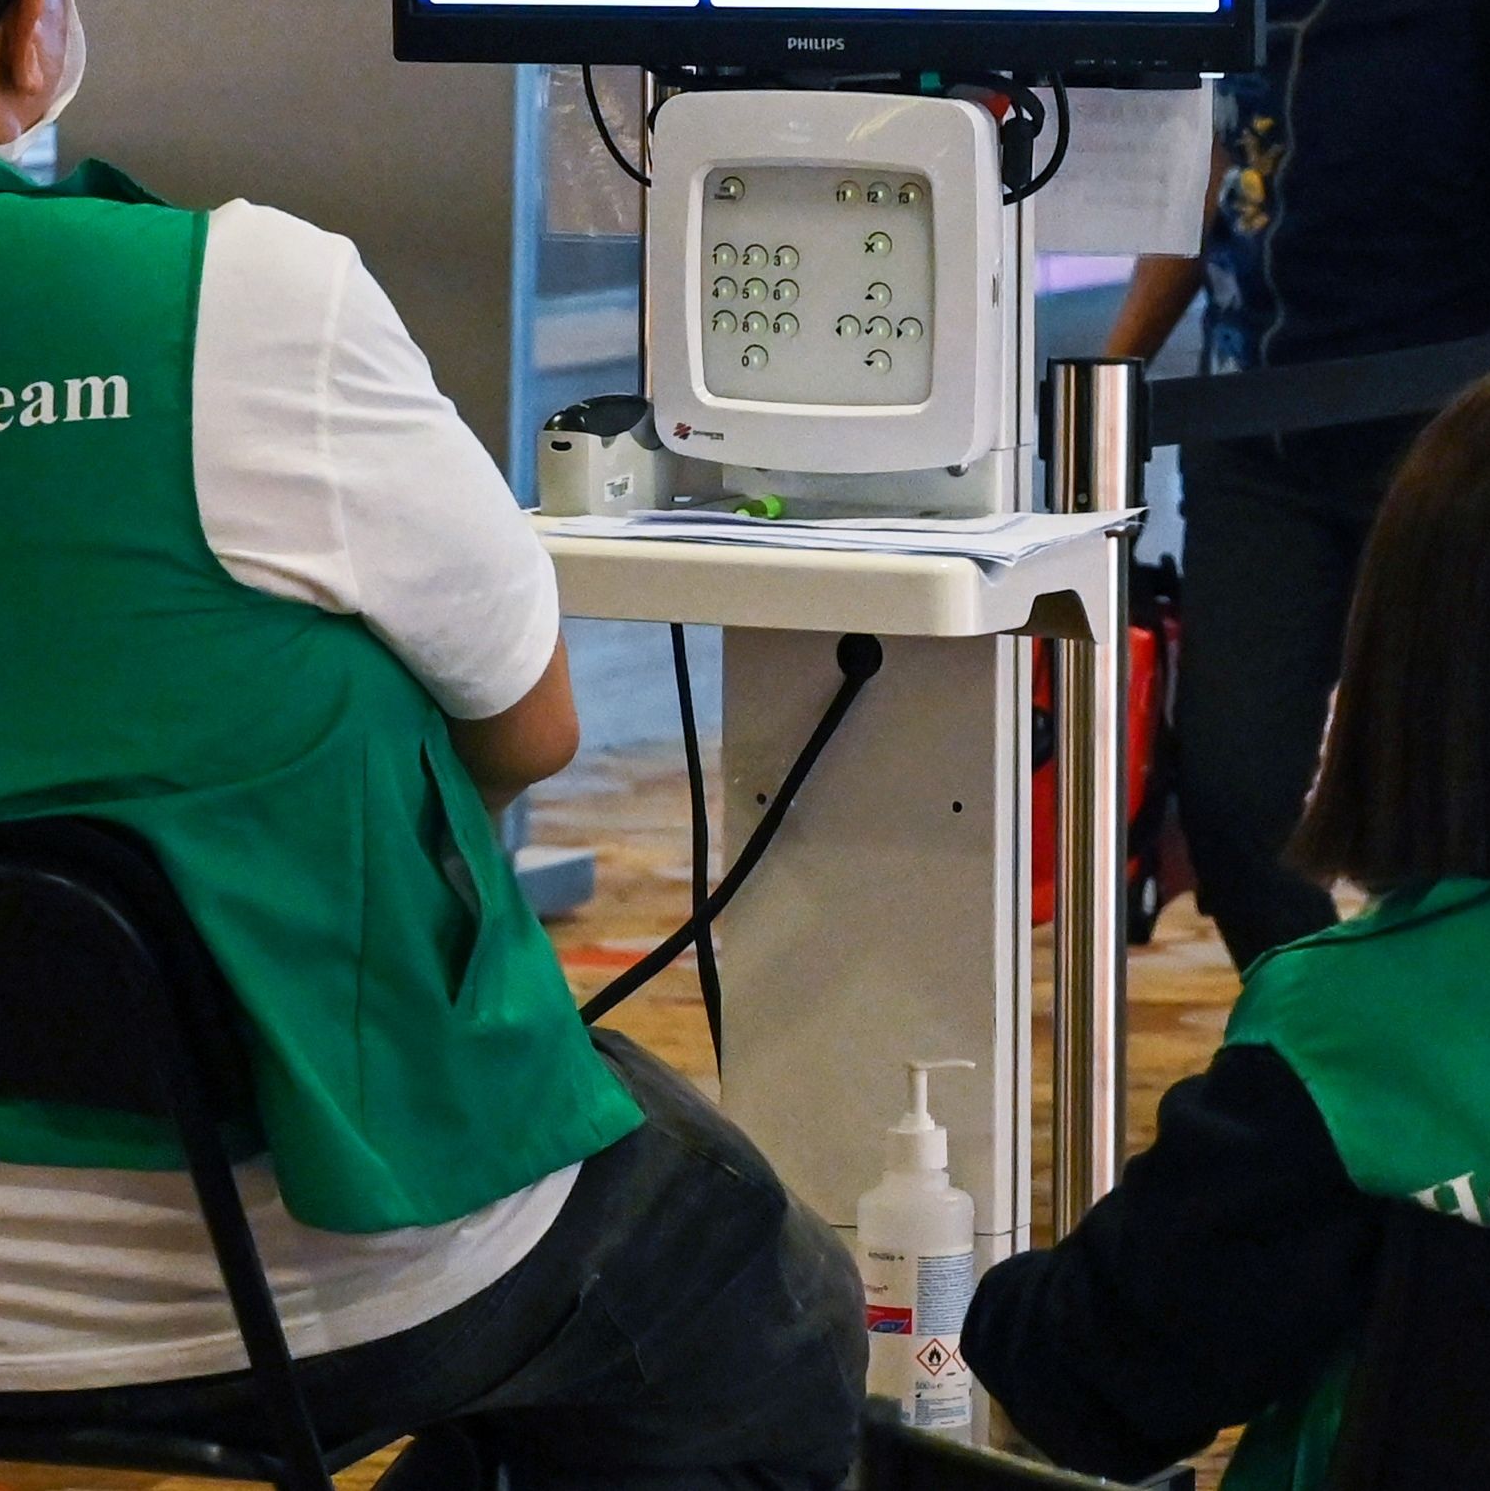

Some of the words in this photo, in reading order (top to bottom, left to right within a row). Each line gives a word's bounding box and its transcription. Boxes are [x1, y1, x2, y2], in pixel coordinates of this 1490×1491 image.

[787, 37, 846, 51] PHILIPS
[866, 191, 879, 203] f2
[898, 192, 910, 204] f3
[712, 254, 718, 265] 1
[742, 254, 750, 266] 2
[774, 255, 782, 267] 3
[712, 288, 719, 299] 4
[742, 288, 750, 299] 5
[773, 289, 781, 300] 6
[712, 320, 719, 331] 7
[742, 321, 749, 333] 8
[773, 322, 780, 334] 9
[741, 355, 749, 367] 0
